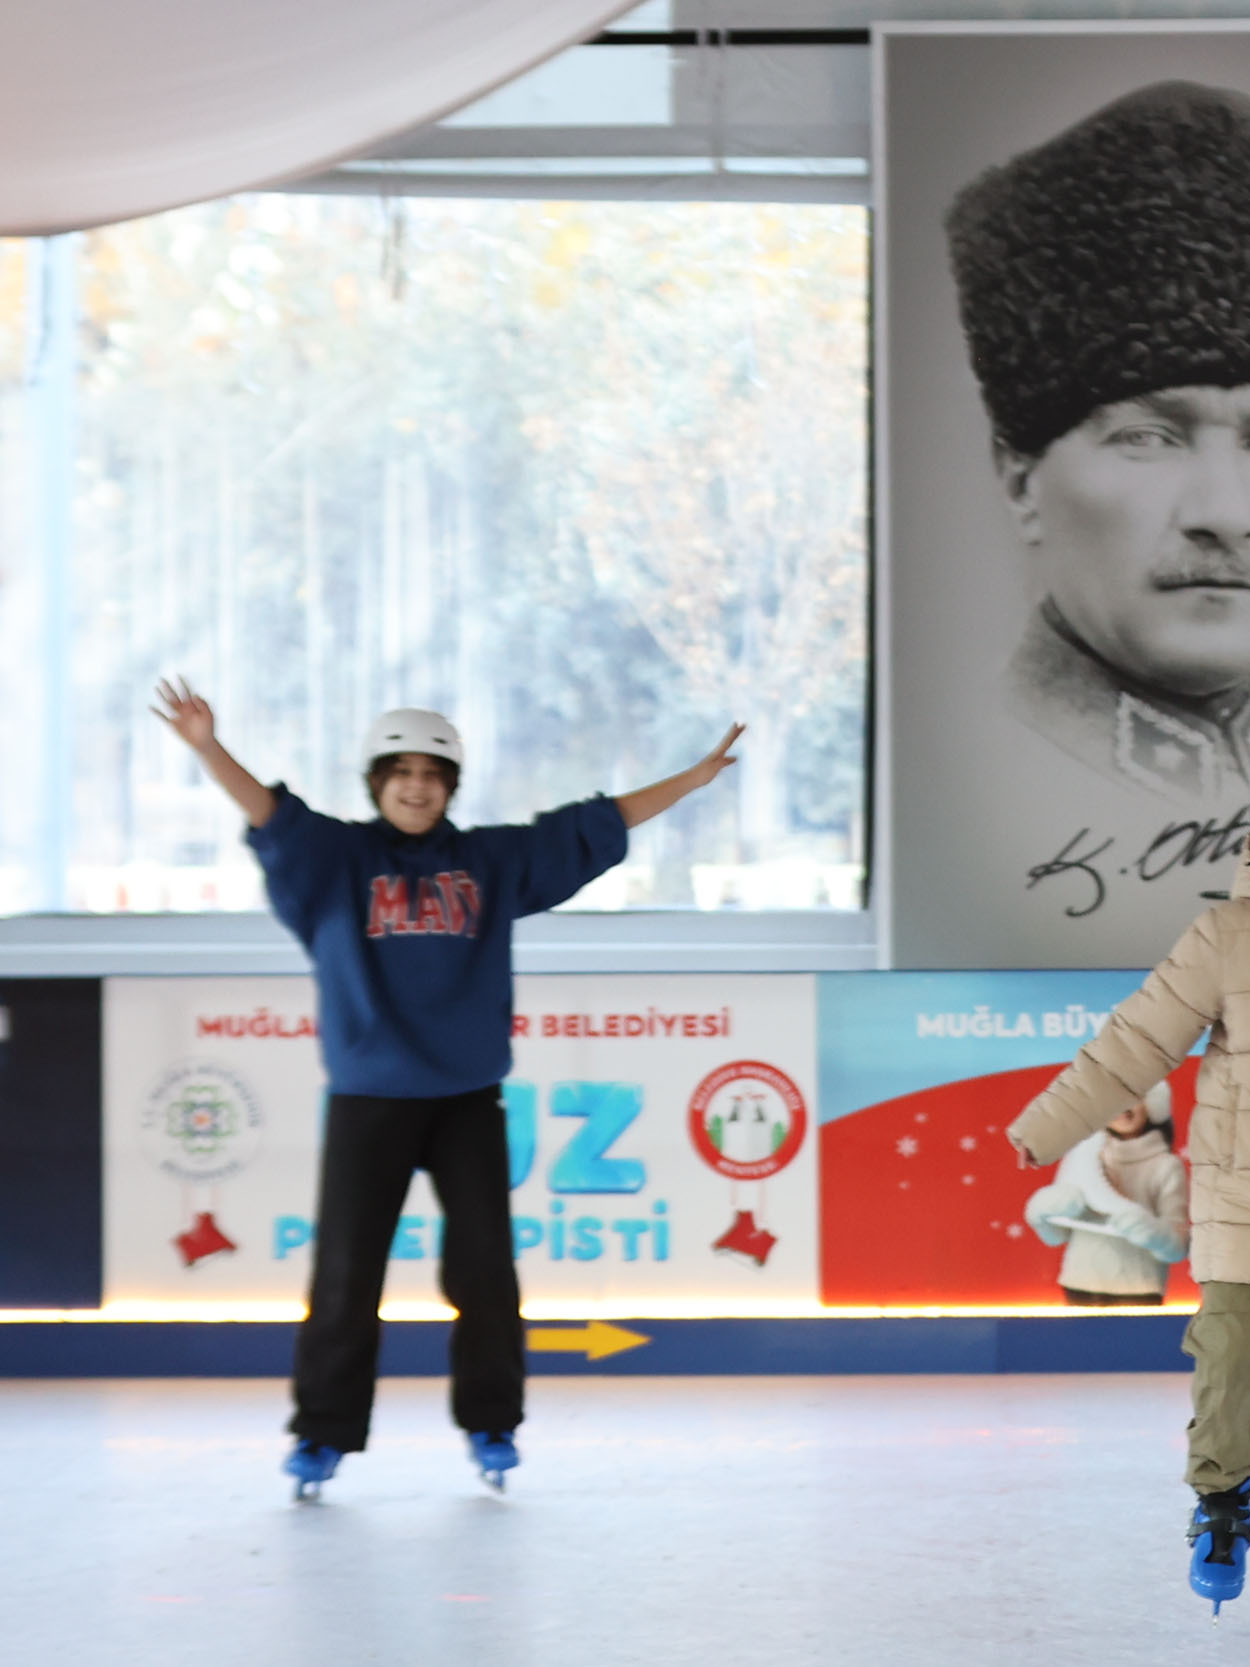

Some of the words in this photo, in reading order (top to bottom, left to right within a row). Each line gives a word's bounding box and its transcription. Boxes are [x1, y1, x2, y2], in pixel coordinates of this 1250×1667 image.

[196, 1007, 318, 1037] MUĞLA
[541, 1007, 728, 1037] BELEDİYESİ
[916, 1005, 1036, 1038] MUĞLA
